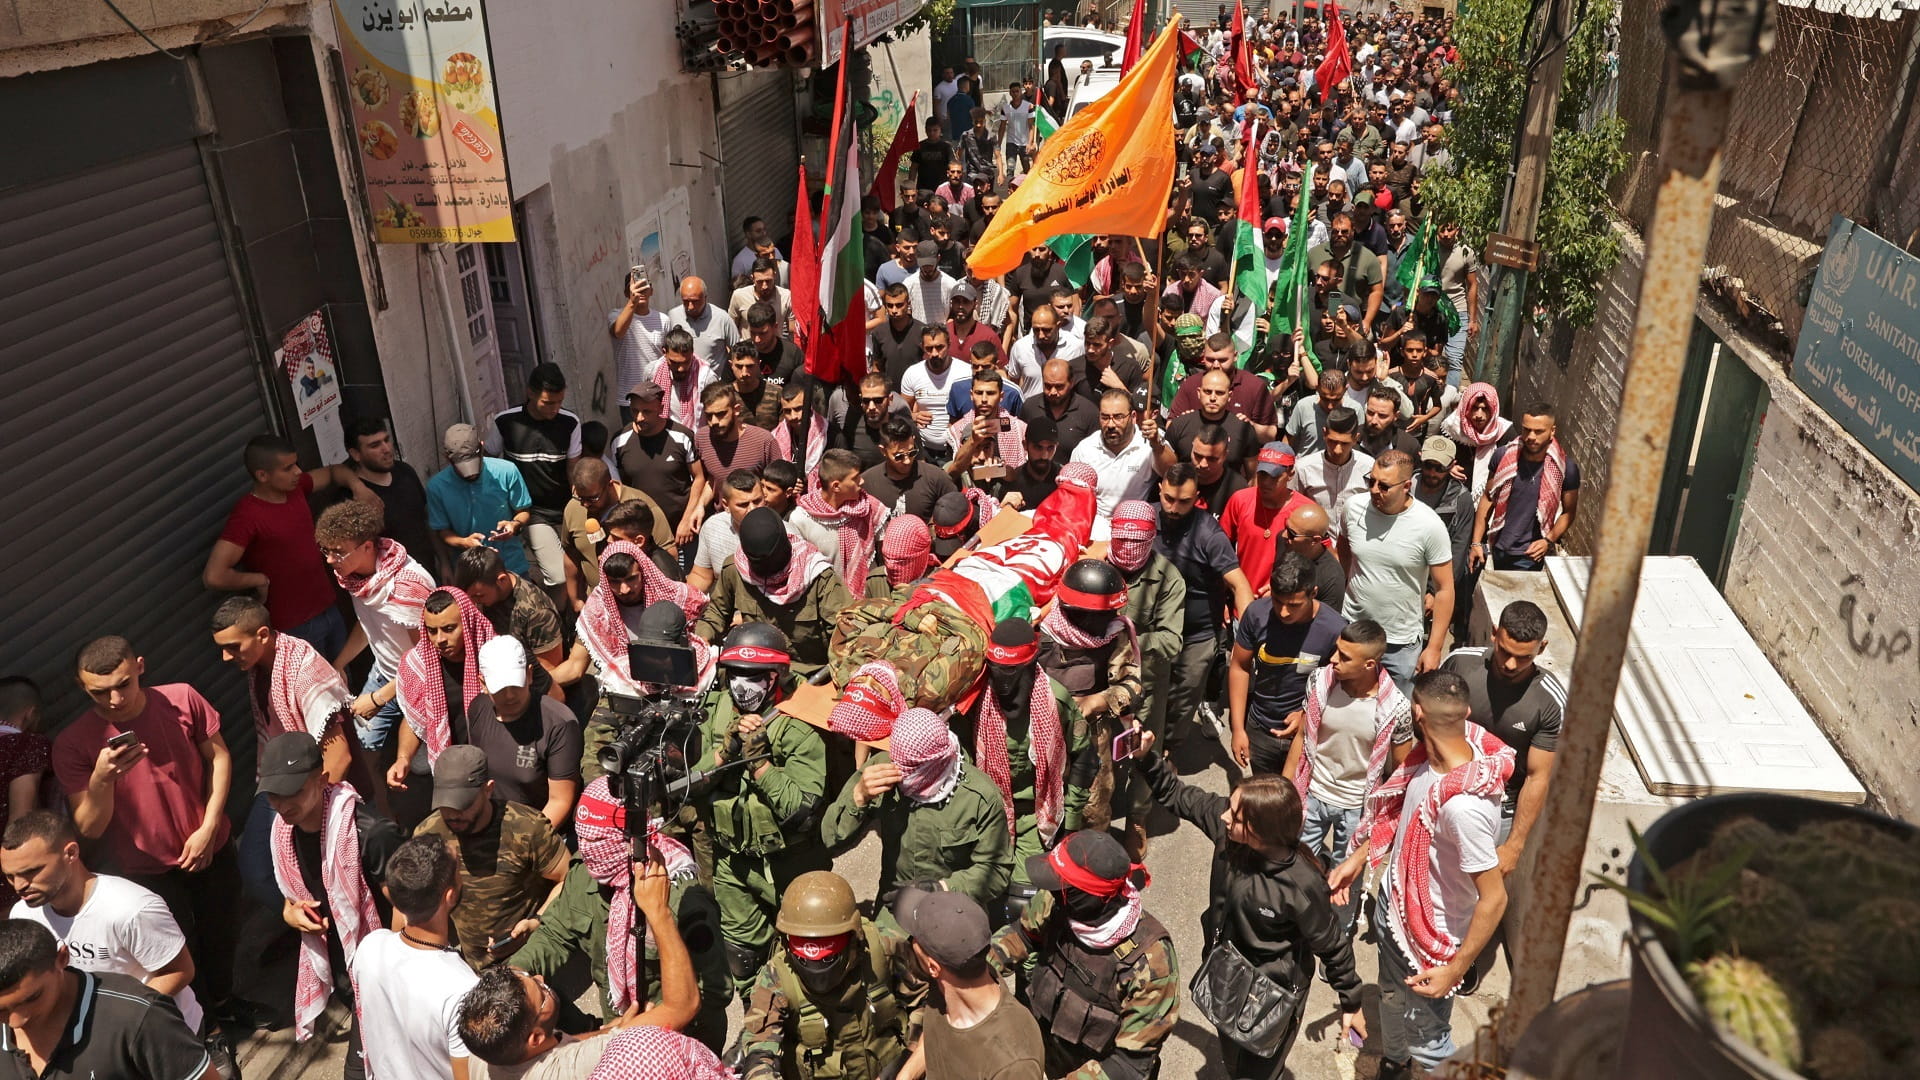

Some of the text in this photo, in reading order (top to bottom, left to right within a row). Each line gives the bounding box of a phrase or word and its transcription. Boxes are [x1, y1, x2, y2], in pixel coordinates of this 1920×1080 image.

[363, 2, 394, 31] يزن
[424, 0, 473, 31] مطعم
[1098, 167, 1132, 196] المبادرة
[444, 195, 473, 206] محمد
[1813, 287, 1844, 320] unrwa
[1804, 343, 1834, 388] البيئة
[1840, 336, 1896, 394] FOREMAN
[324, 393, 337, 405] محمد
[1833, 366, 1858, 409] صحة
[1858, 395, 1892, 440] مراقب
